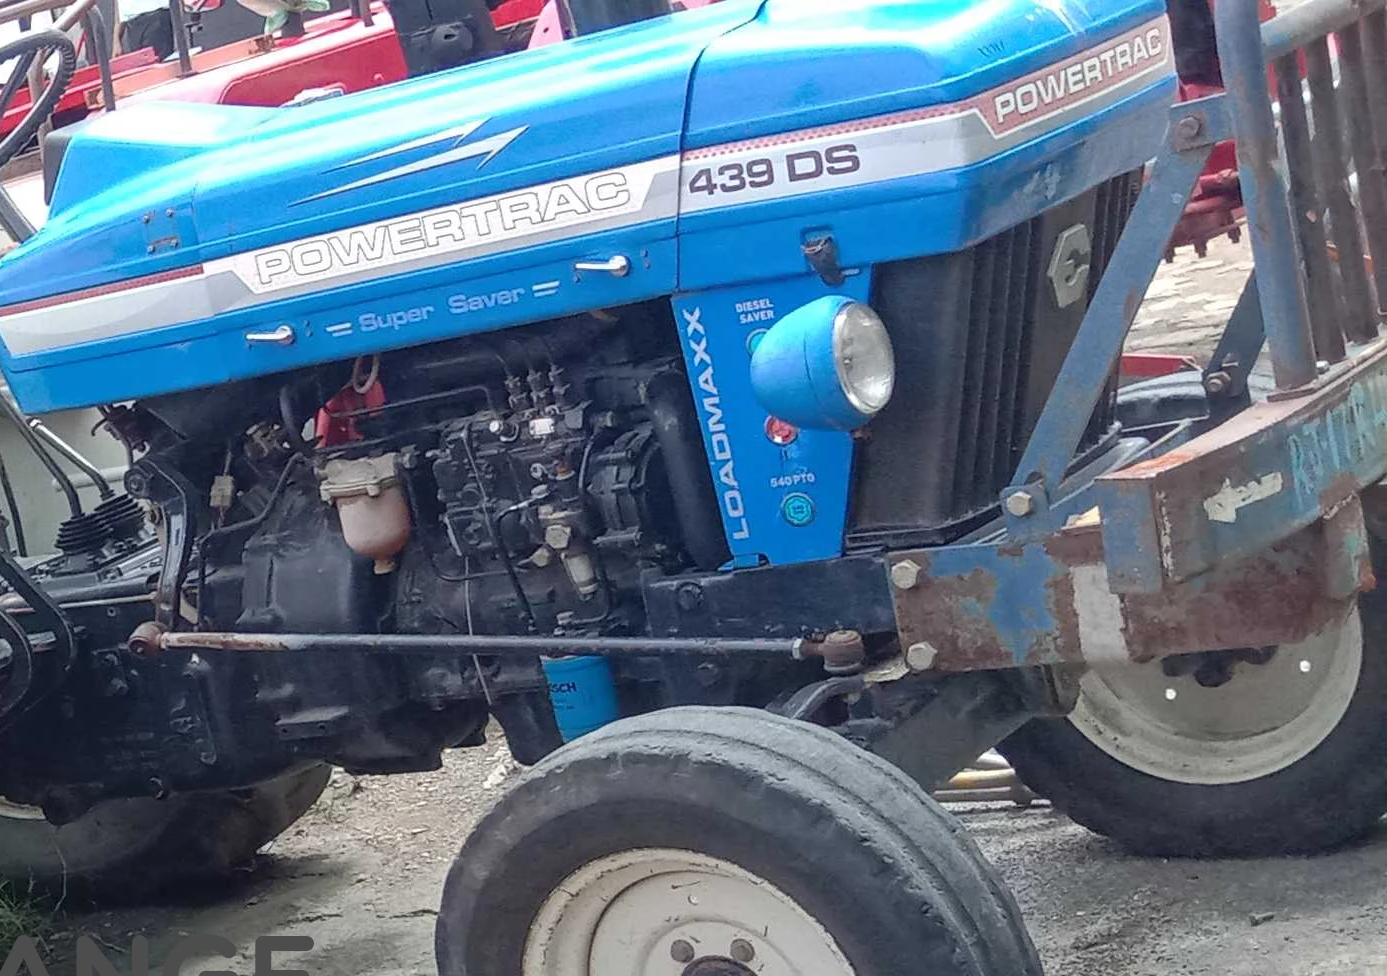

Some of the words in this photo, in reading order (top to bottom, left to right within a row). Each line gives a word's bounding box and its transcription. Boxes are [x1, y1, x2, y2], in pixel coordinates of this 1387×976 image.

[994, 27, 1162, 124] POWERTRAC
[688, 160, 775, 197] 439
[786, 143, 861, 181] DS
[255, 172, 631, 285] POWERTRAC
[359, 304, 435, 334] Super
[448, 286, 525, 315] Saver
[735, 298, 775, 314] DIESEL
[739, 309, 776, 325] SAVER
[682, 306, 751, 540] LOADMAXX
